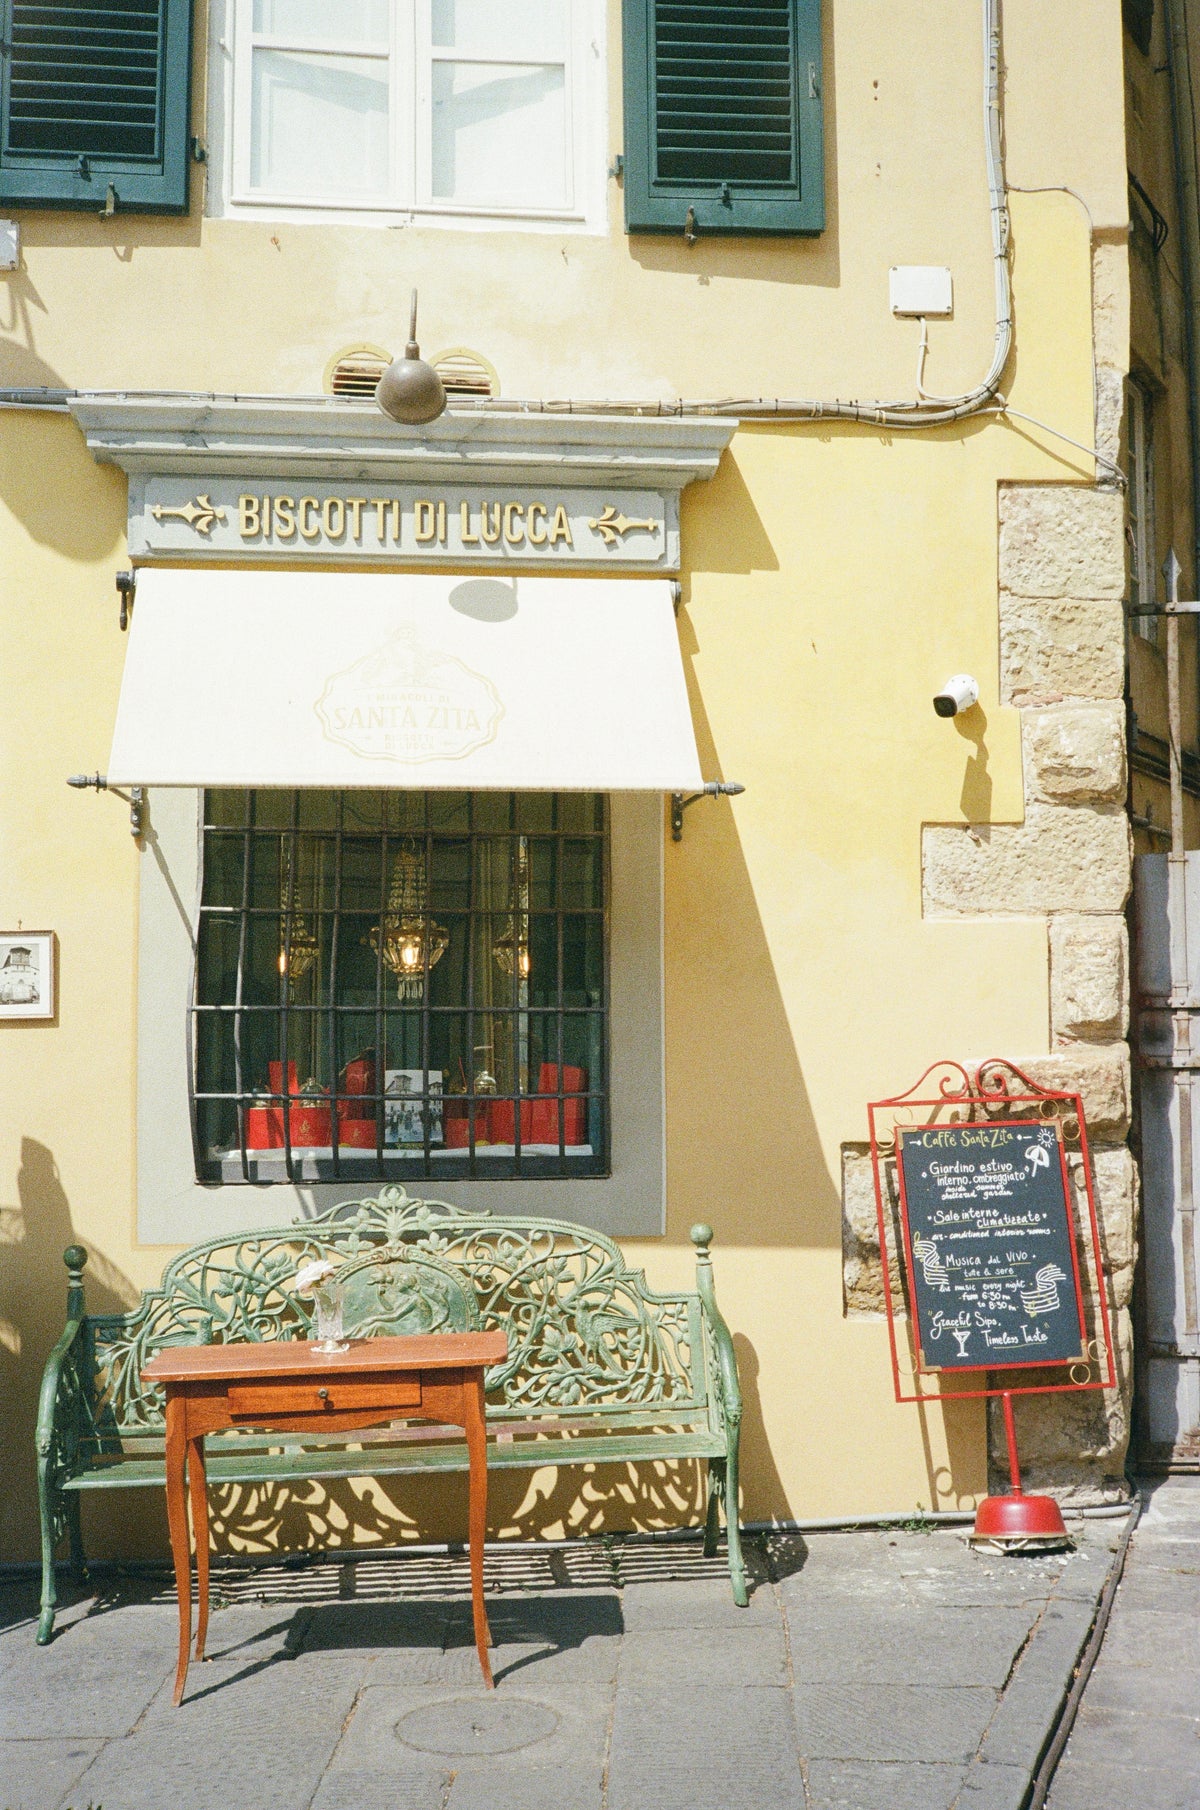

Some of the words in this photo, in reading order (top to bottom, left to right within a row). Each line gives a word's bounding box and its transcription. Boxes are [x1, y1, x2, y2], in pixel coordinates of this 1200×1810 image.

[238, 494, 400, 540] BISCOTTI
[414, 499, 446, 542] DI
[459, 500, 574, 544] LUCCA
[334, 705, 418, 730] SANTA
[426, 706, 482, 732] ZITA
[960, 1129, 990, 1148] Santa
[989, 1128, 1013, 1148] Zita
[929, 1160, 975, 1175] Giardino
[979, 1159, 1013, 1172] estivo
[972, 1171, 1026, 1185] ombreggiato
[941, 1190, 978, 1200] sheltered
[982, 1189, 1013, 1200] garden
[933, 1210, 960, 1223] Sale
[961, 1207, 999, 1220] interne
[976, 1210, 1041, 1228] climatizzate
[994, 1228, 1025, 1237] interior
[945, 1253, 981, 1267] Musica
[987, 1256, 1000, 1264] dal
[963, 1269, 980, 1277] tutte
[995, 1267, 1014, 1275] sere
[982, 1282, 1002, 1291] every
[1005, 1280, 1025, 1292] night
[962, 1292, 979, 1300] from
[981, 1291, 1001, 1301] 6:30
[988, 1301, 1007, 1310] 8:30
[981, 1329, 1019, 1347] Timeless
